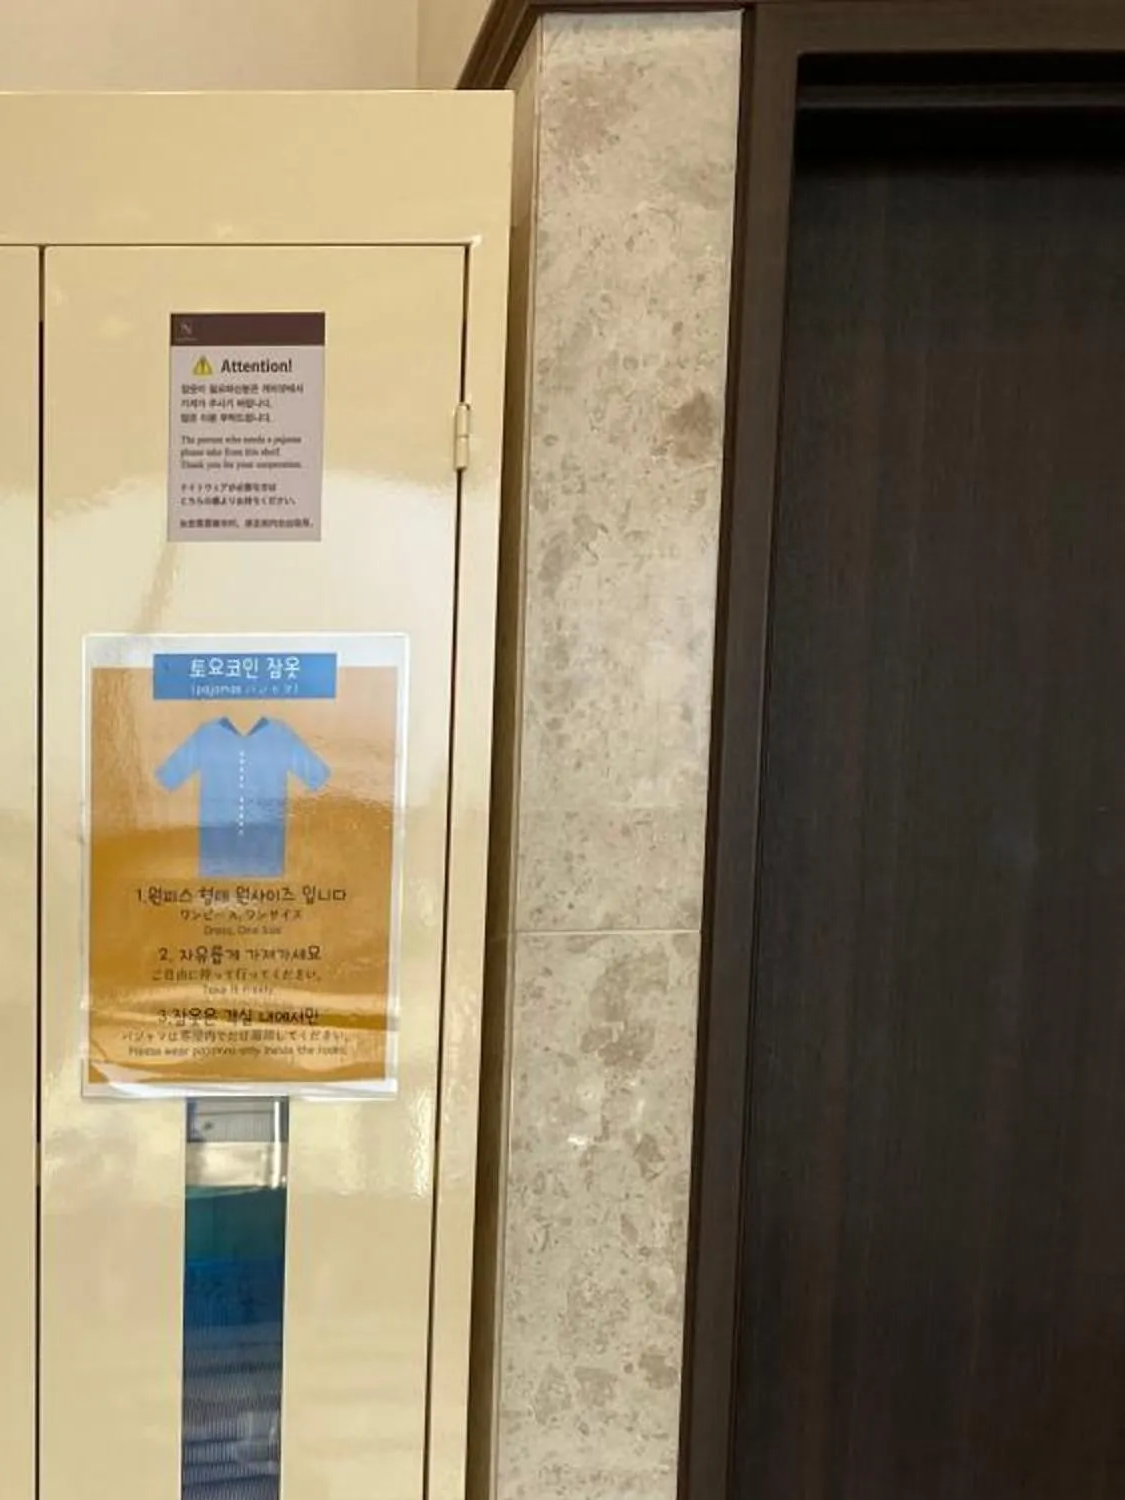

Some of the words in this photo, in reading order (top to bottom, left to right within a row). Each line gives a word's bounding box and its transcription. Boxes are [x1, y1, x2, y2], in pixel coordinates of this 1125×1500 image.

[220, 358, 293, 373] Attention!
[188, 657, 260, 680] 토요코인
[266, 656, 301, 680] 잠옷
[236, 886, 296, 906] 원사이즈
[302, 885, 347, 905] 입니다
